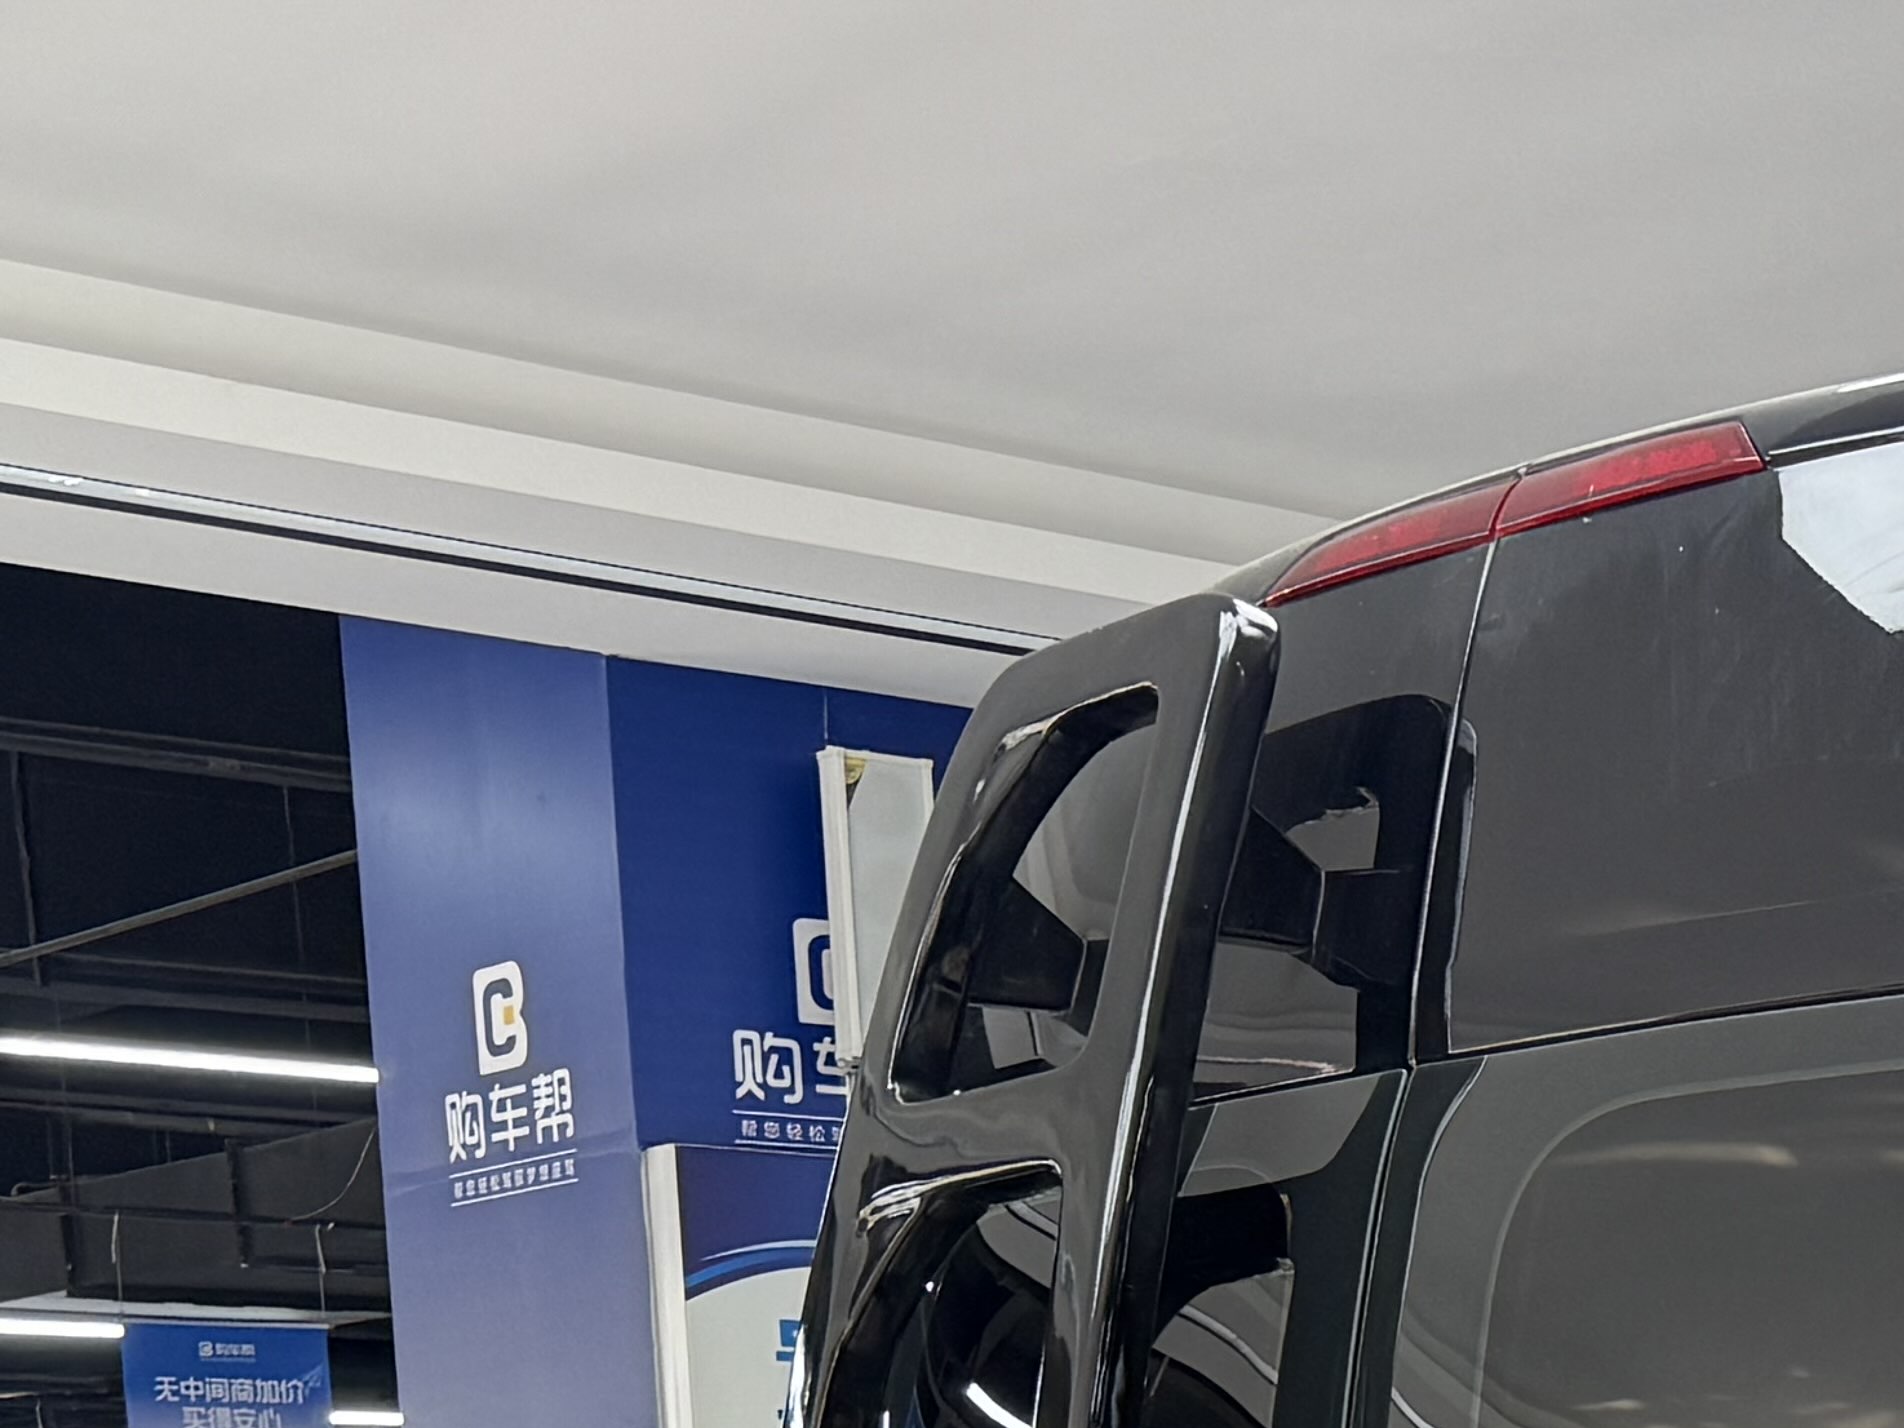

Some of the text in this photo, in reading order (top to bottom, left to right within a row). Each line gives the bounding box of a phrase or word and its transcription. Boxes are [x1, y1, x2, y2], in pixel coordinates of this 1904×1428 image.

[444, 1067, 575, 1164] 购车帮
[153, 1375, 305, 1406] 无中间商加价
